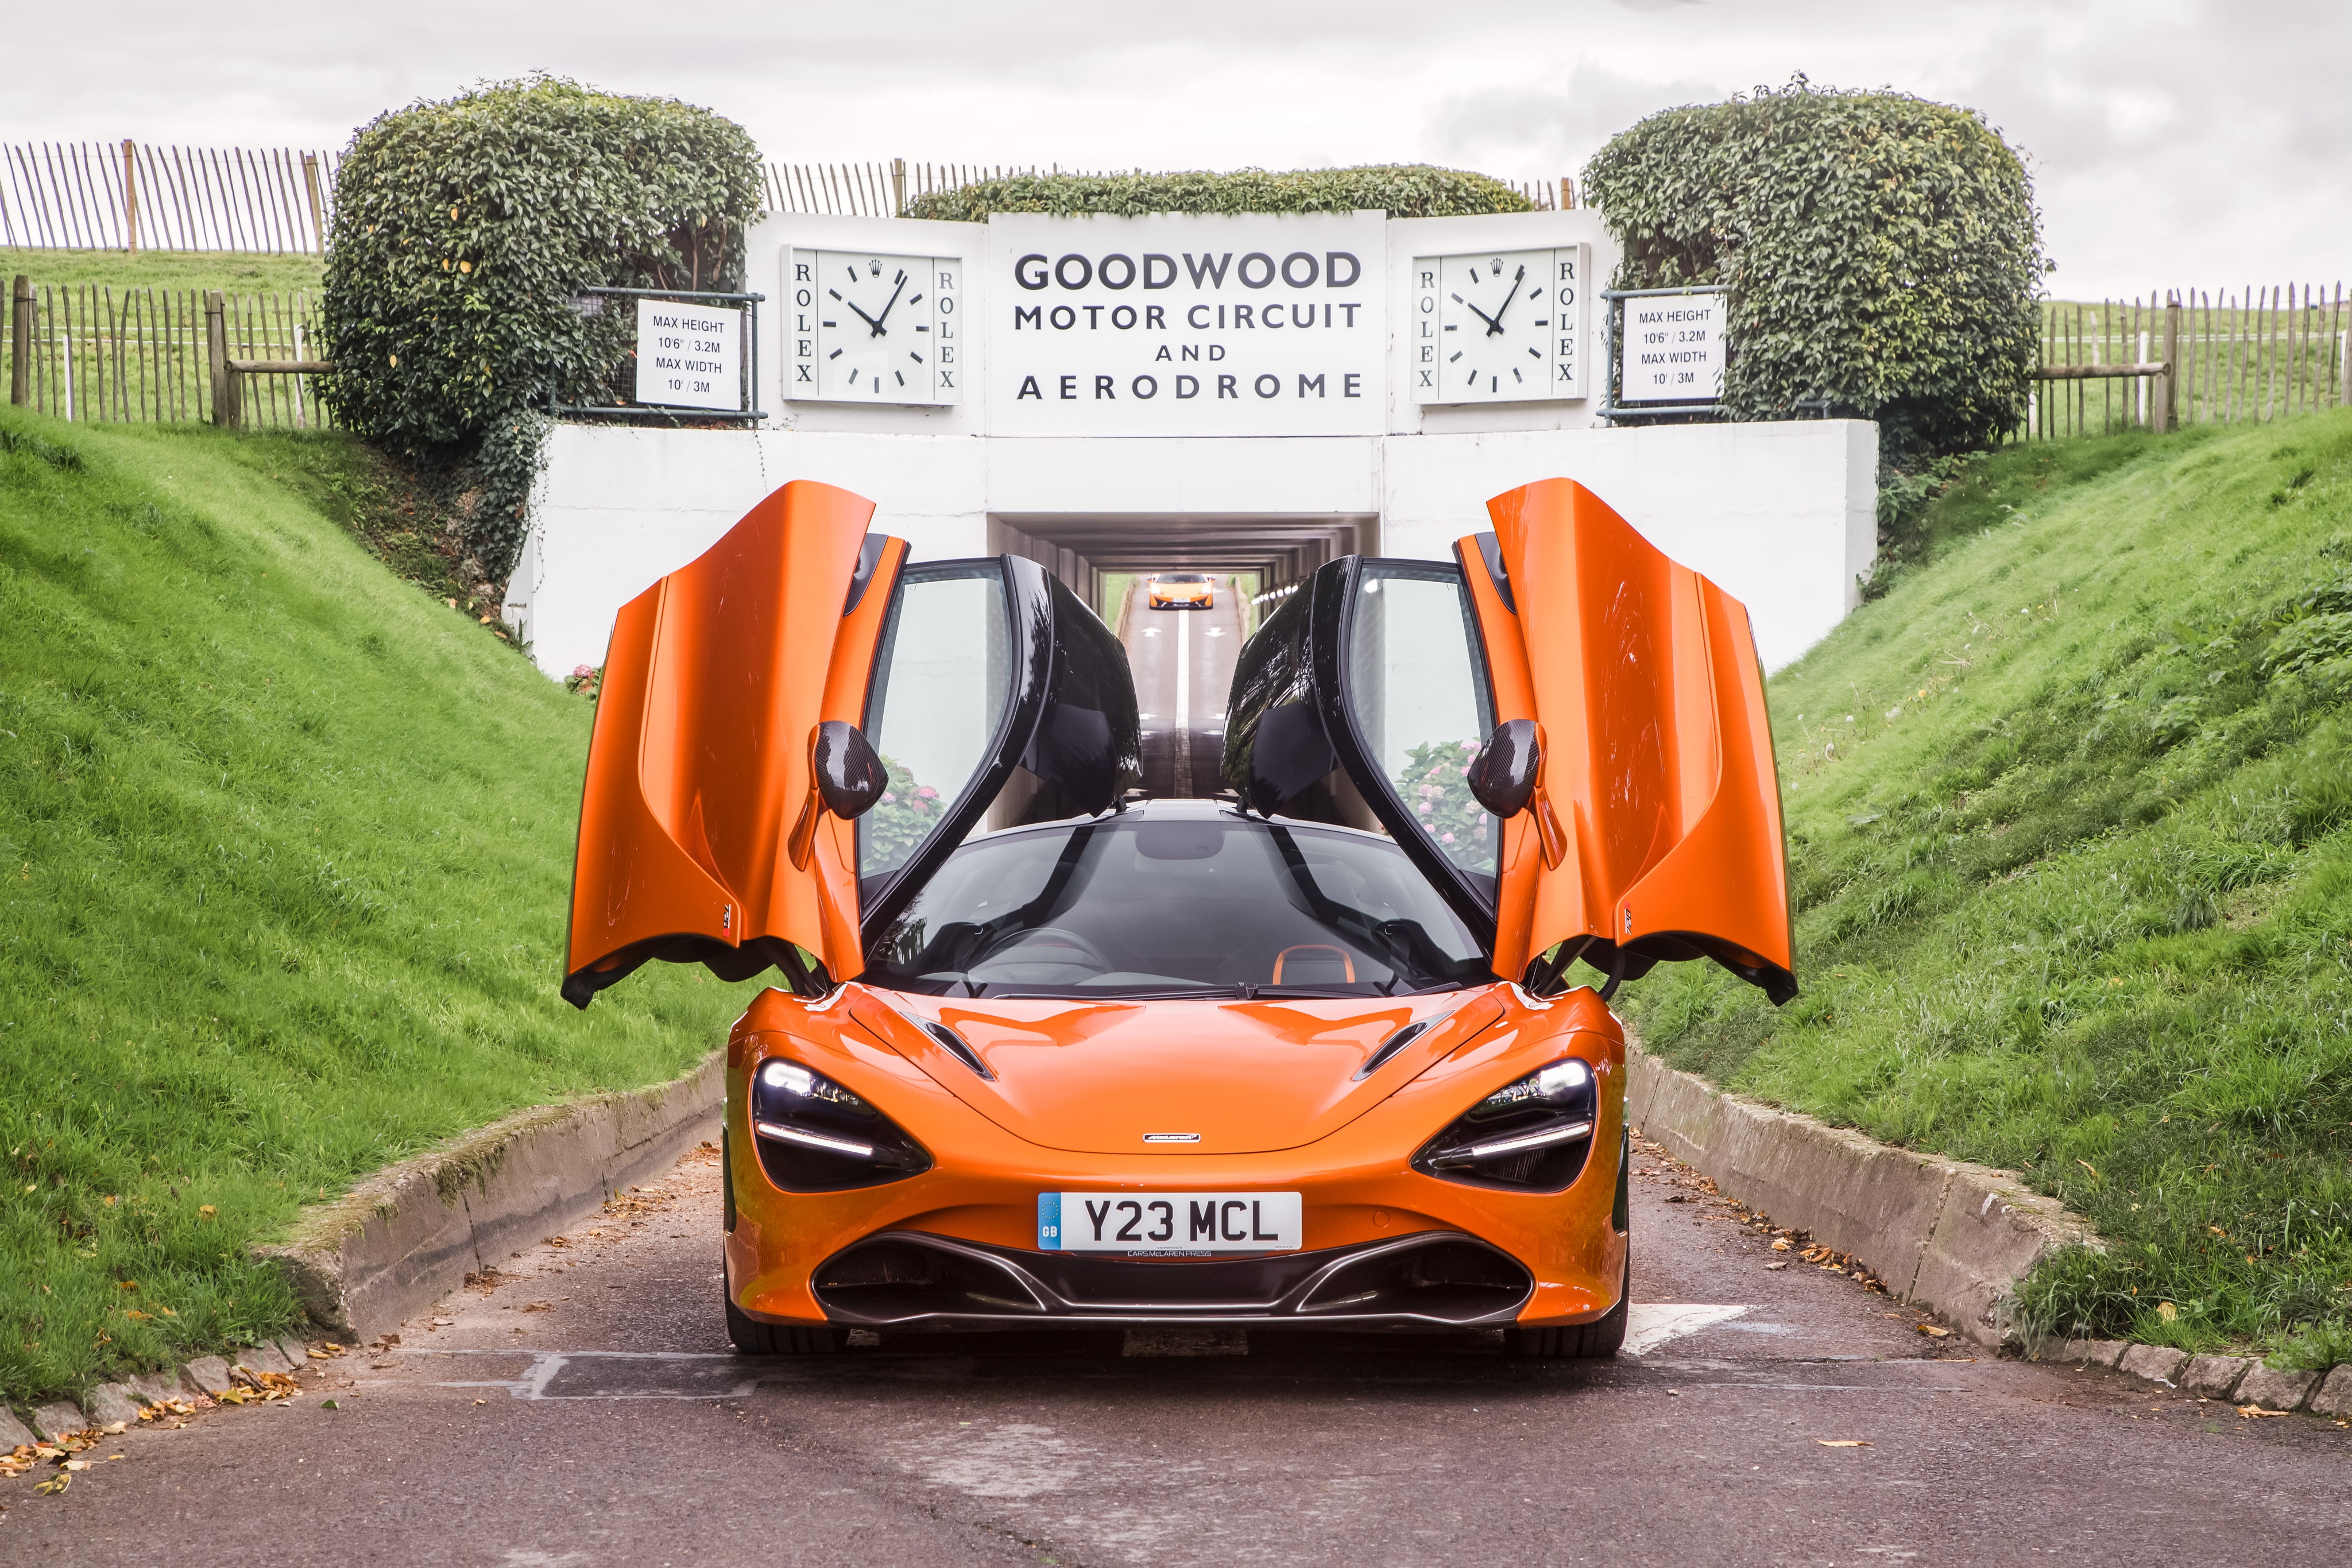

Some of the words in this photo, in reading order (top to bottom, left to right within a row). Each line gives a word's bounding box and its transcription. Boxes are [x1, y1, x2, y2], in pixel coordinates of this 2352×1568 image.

[1015, 252, 1360, 290] GOODWOOD
[653, 316, 678, 328] MAX
[683, 319, 724, 332] HEIGHT
[795, 264, 812, 381] ROLEX
[1015, 305, 1166, 330] MOTOR
[1188, 304, 1361, 329] CIRCUIT
[1558, 262, 1575, 381] ROLEX
[1640, 312, 1662, 323] MAX
[1668, 309, 1711, 322] HEIGHT
[939, 273, 954, 388] ROLEX
[1419, 272, 1434, 386] ROLEX
[1679, 331, 1705, 342] 3.2M
[695, 340, 719, 353] 3.2M
[1155, 344, 1225, 361] AND
[656, 358, 680, 369] MAX
[685, 360, 721, 373] WIDTH
[1642, 353, 1665, 364] MAX
[1669, 351, 1706, 363] WIDTH
[1678, 373, 1693, 383] 3M
[694, 381, 709, 392] 3M
[1017, 374, 1360, 399] AERODROME
[1085, 1201, 1173, 1241] Y23
[1190, 1201, 1278, 1241] MCL
[1042, 1226, 1057, 1237] GB
